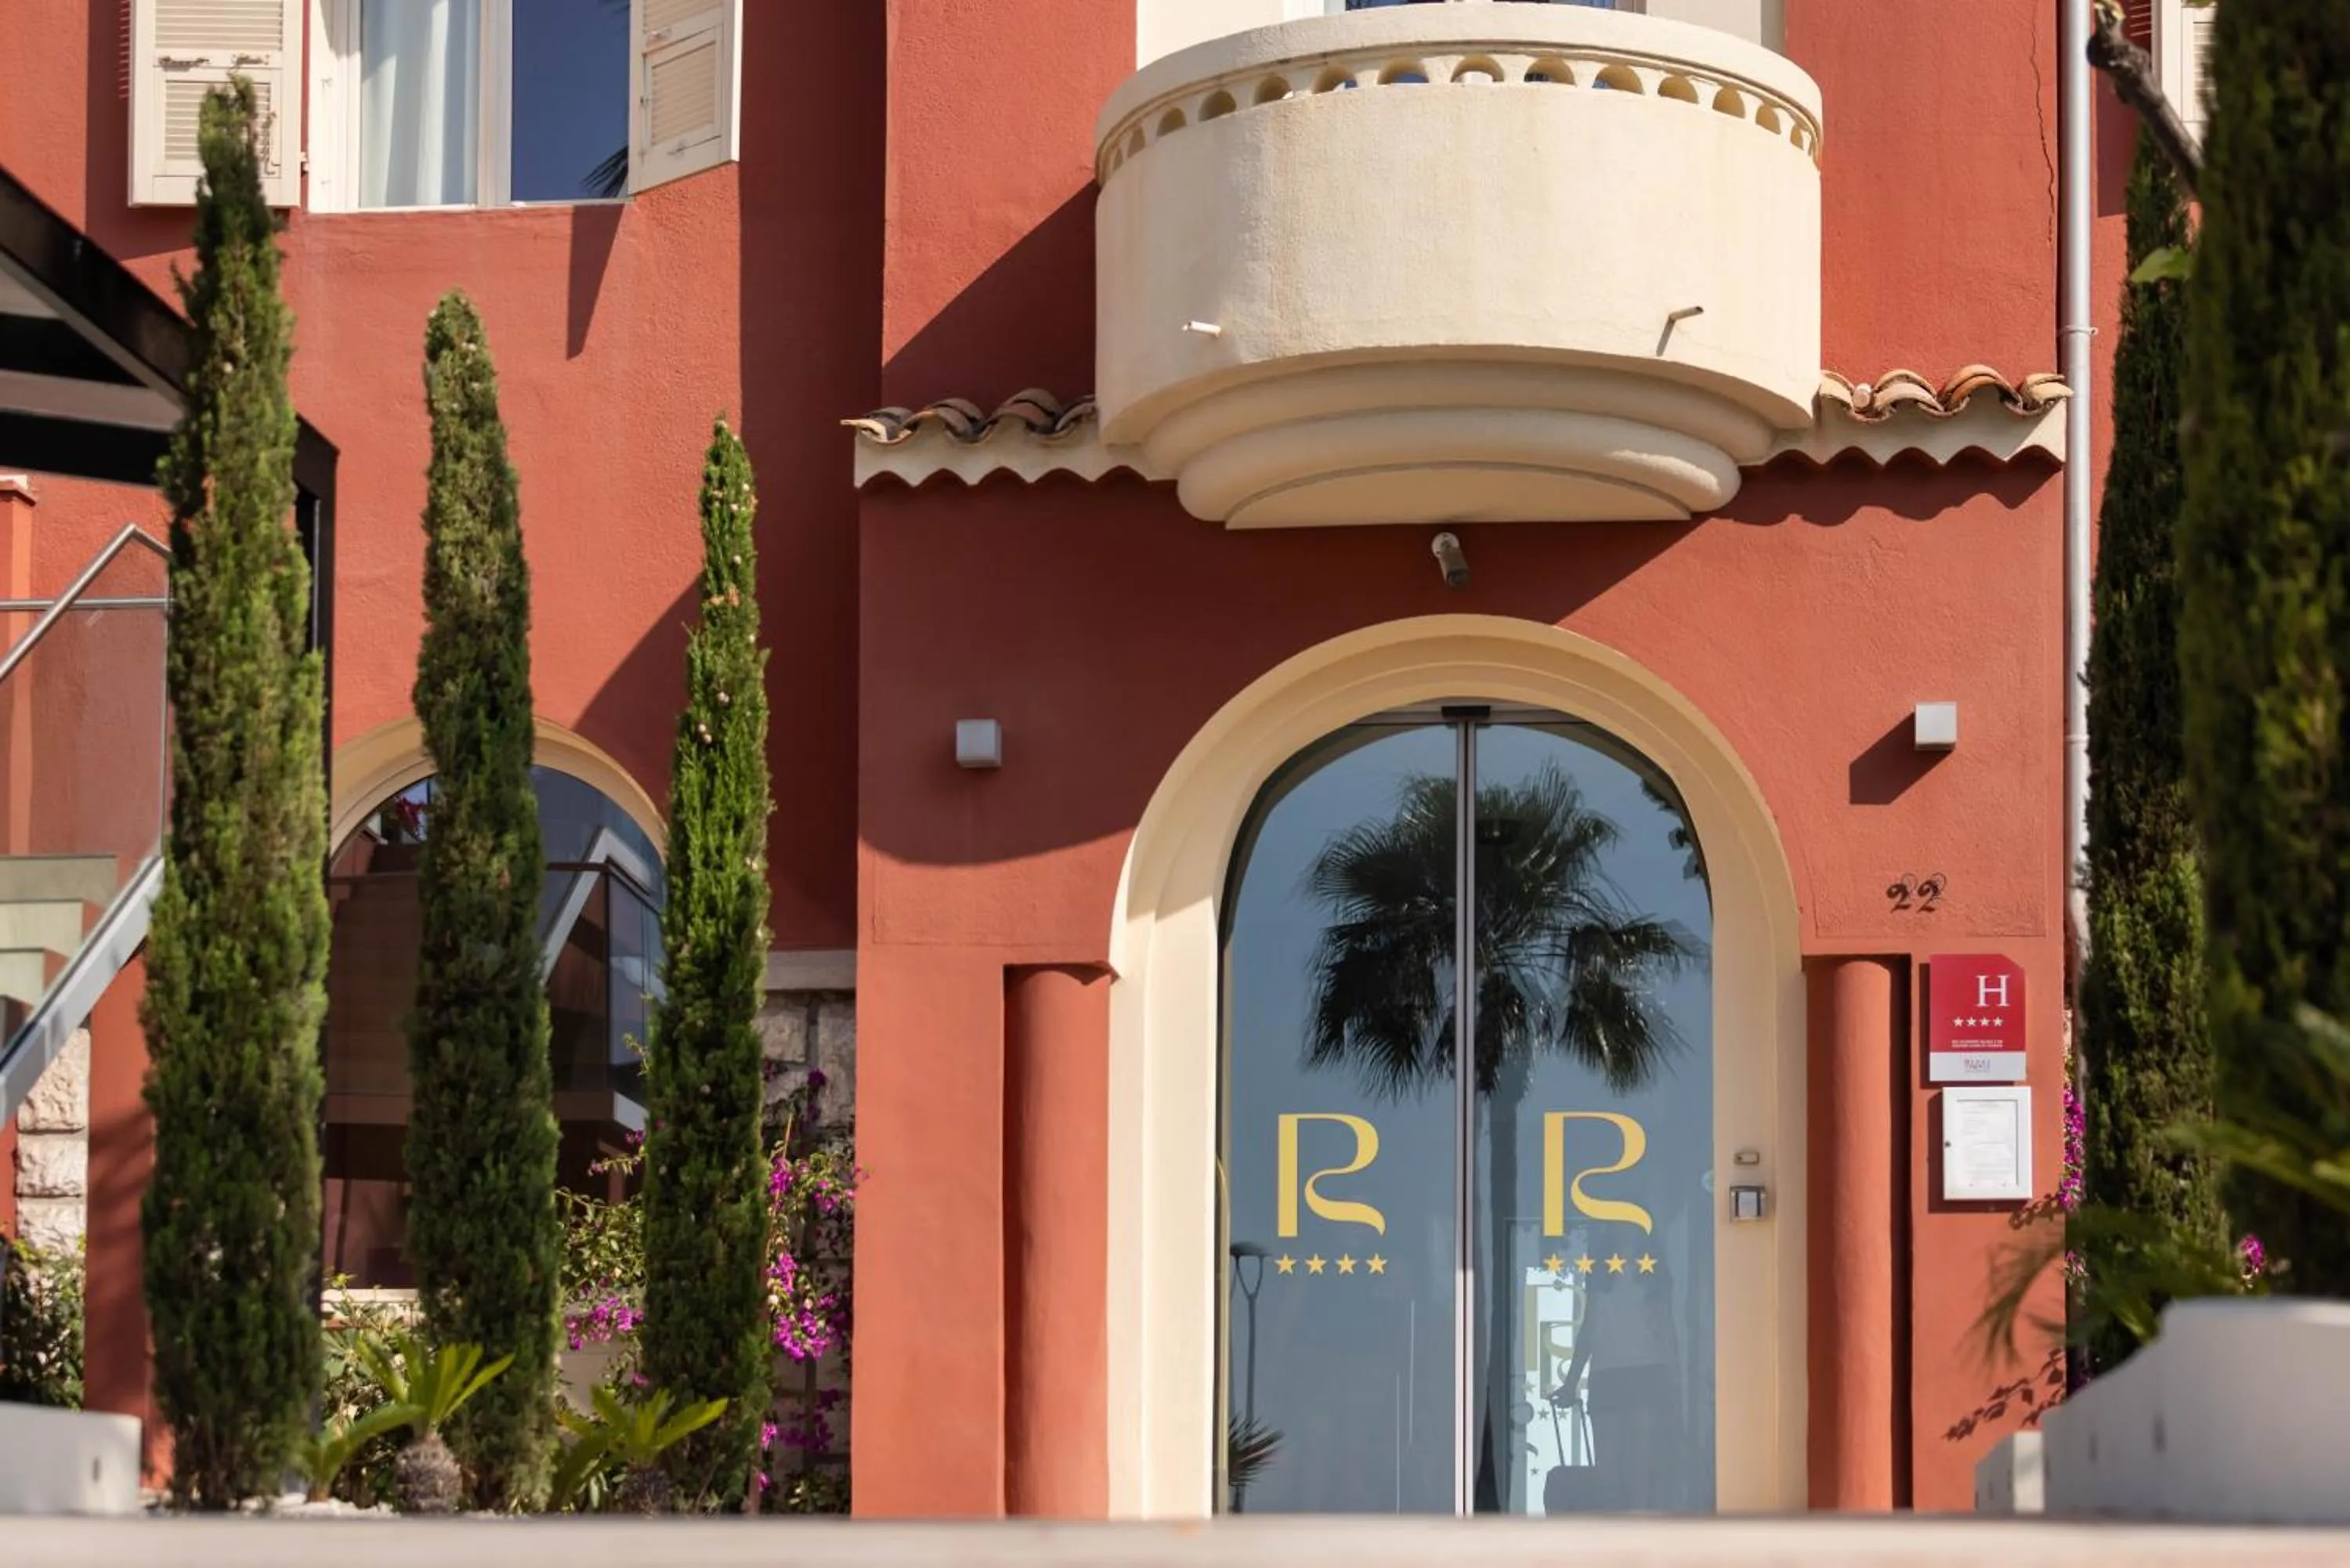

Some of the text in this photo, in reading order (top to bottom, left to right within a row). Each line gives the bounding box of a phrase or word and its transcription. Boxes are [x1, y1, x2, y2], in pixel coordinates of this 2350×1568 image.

[1885, 872, 1947, 913] 22
[1976, 975, 2009, 1007] H
[1277, 1113, 1386, 1237] R
[1543, 1111, 1653, 1237] R
